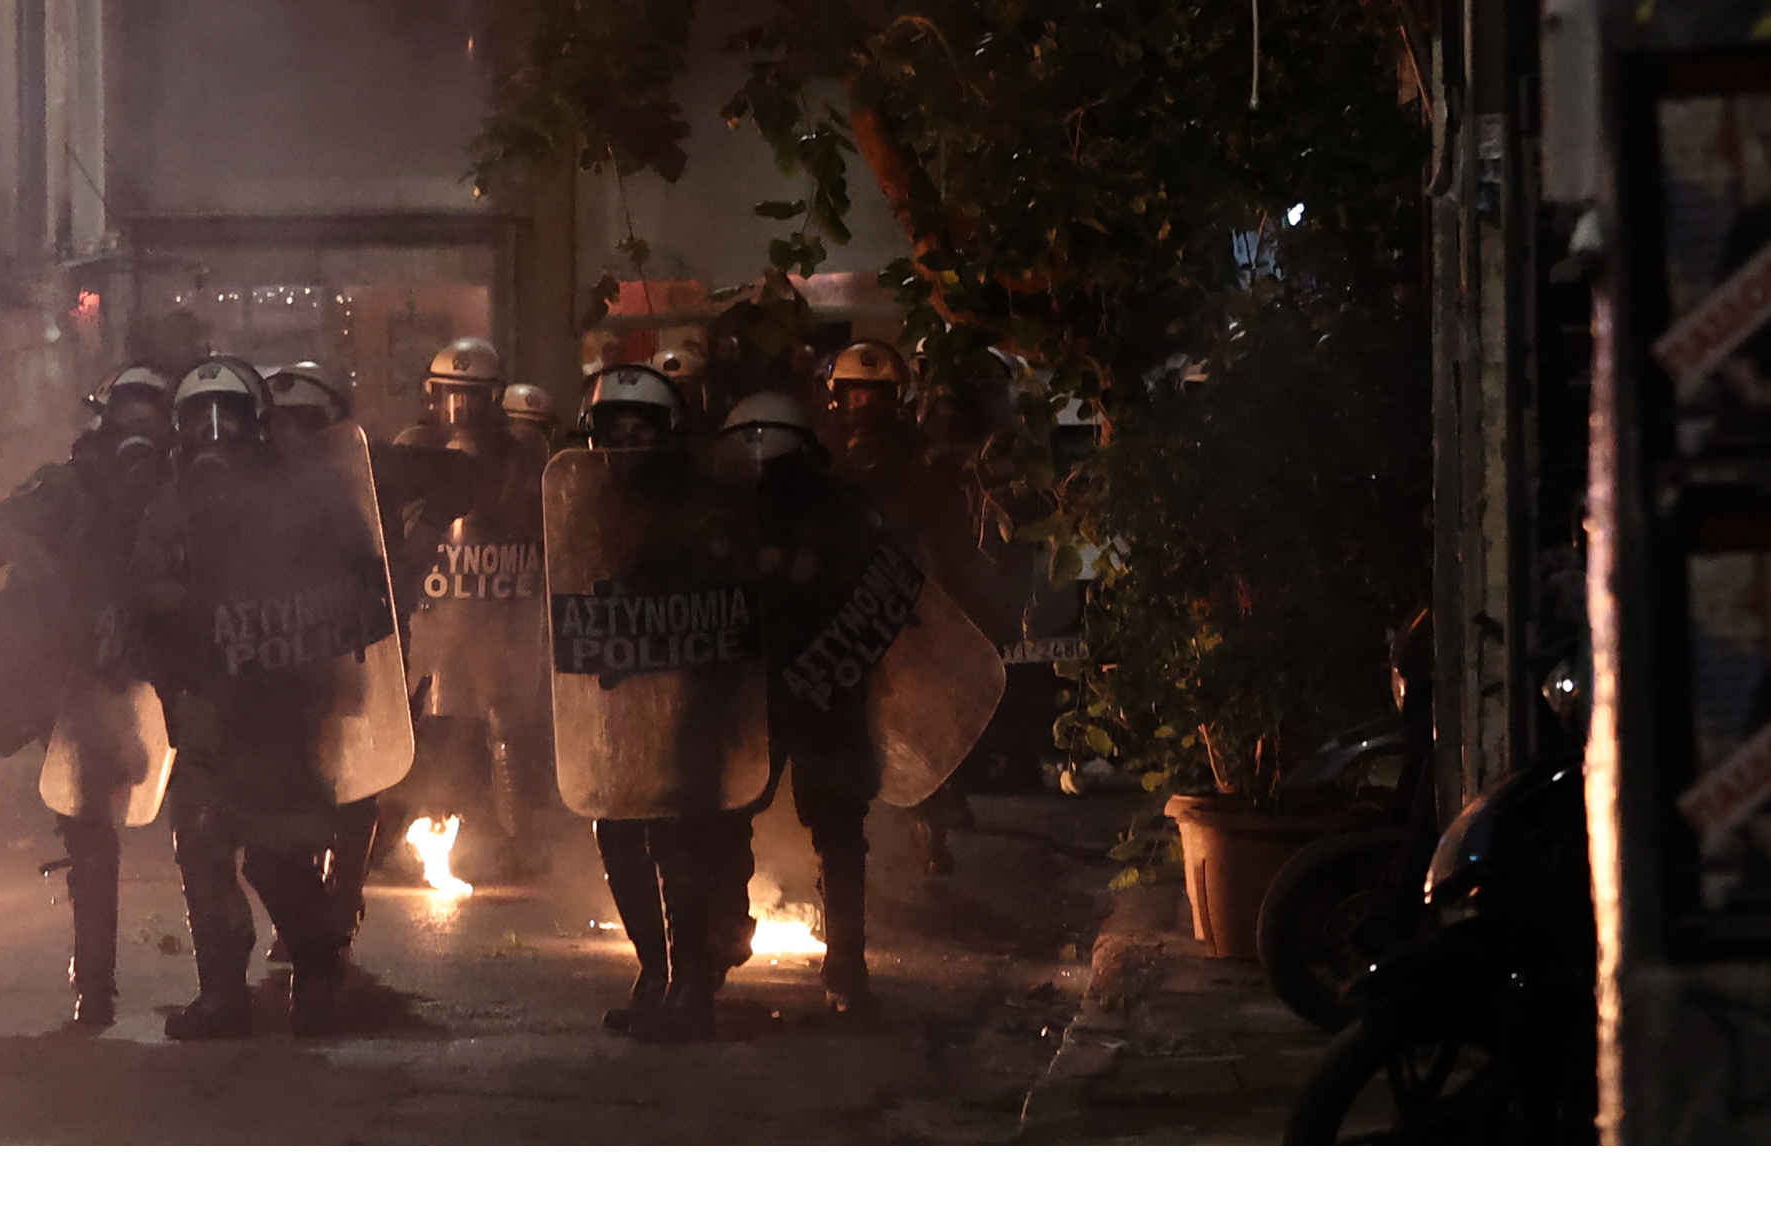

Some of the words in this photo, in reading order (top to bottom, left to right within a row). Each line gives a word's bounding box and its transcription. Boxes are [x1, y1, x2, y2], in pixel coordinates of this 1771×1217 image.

[436, 542, 540, 573] ΥΝΟΜΙΑ
[423, 572, 535, 600] OLICE
[562, 586, 750, 638] ΑΣΤΥΝΟΜΙΑ
[571, 628, 744, 670] POLICE
[810, 578, 920, 713] POLICE
